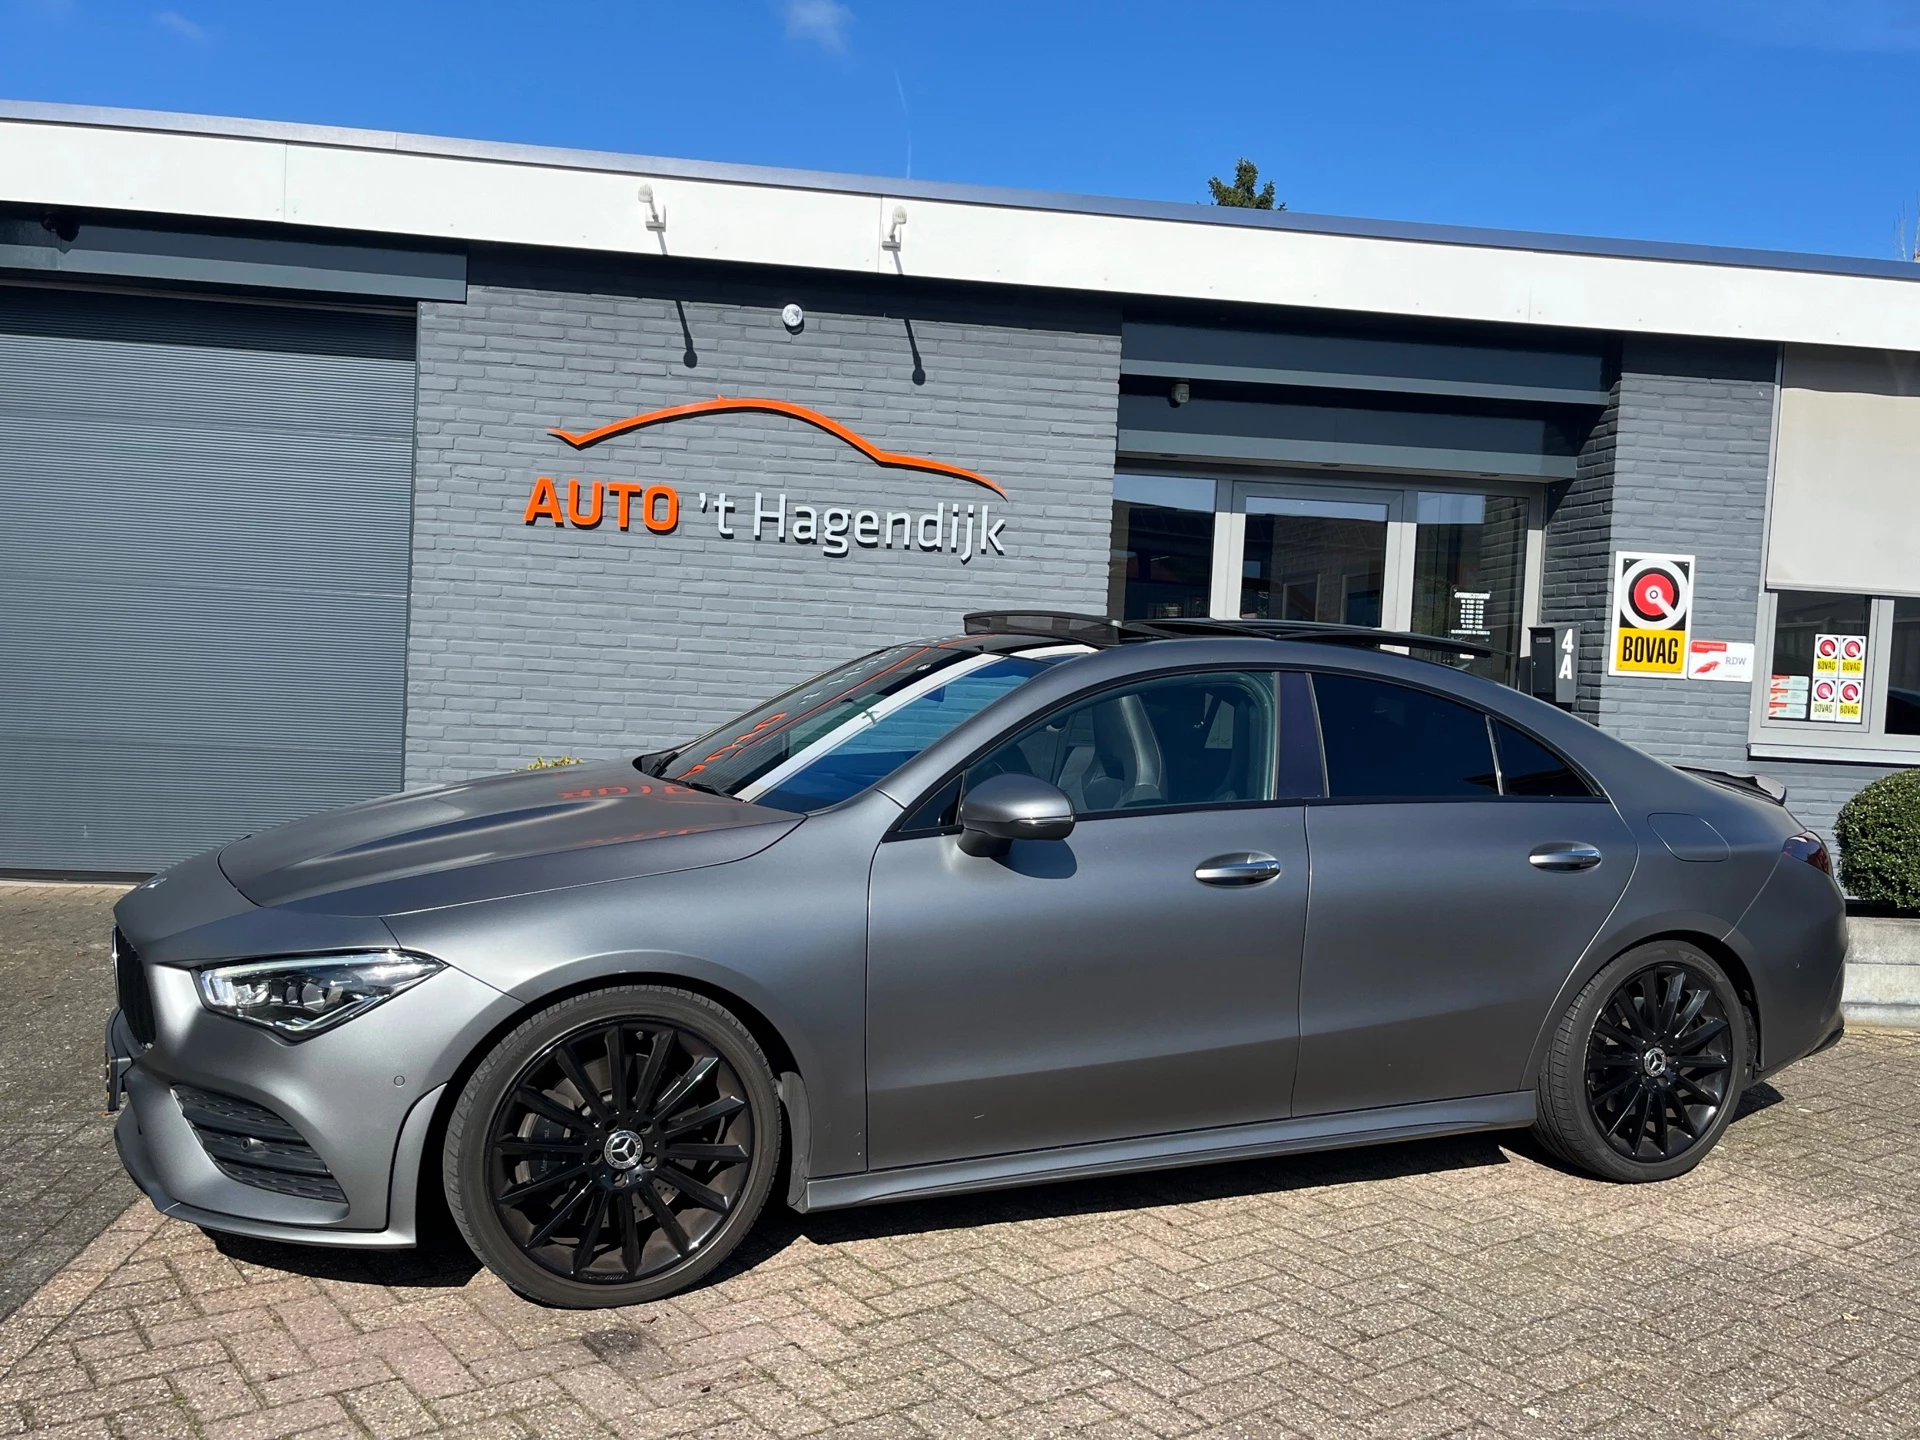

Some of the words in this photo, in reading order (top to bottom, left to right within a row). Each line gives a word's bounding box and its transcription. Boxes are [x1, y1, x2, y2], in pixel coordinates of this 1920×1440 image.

[523, 477, 678, 531] AUTO
[753, 491, 1006, 562] Hagendijk
[1561, 628, 1574, 654] 4
[1622, 635, 1679, 665] BOVAG
[1725, 656, 1747, 666] RDW
[1817, 660, 1836, 671] BOVAG
[1842, 661, 1861, 671] BOVAG
[1558, 654, 1573, 680] A
[1814, 703, 1833, 714] BOVAG
[1839, 704, 1859, 715] BOVAG
